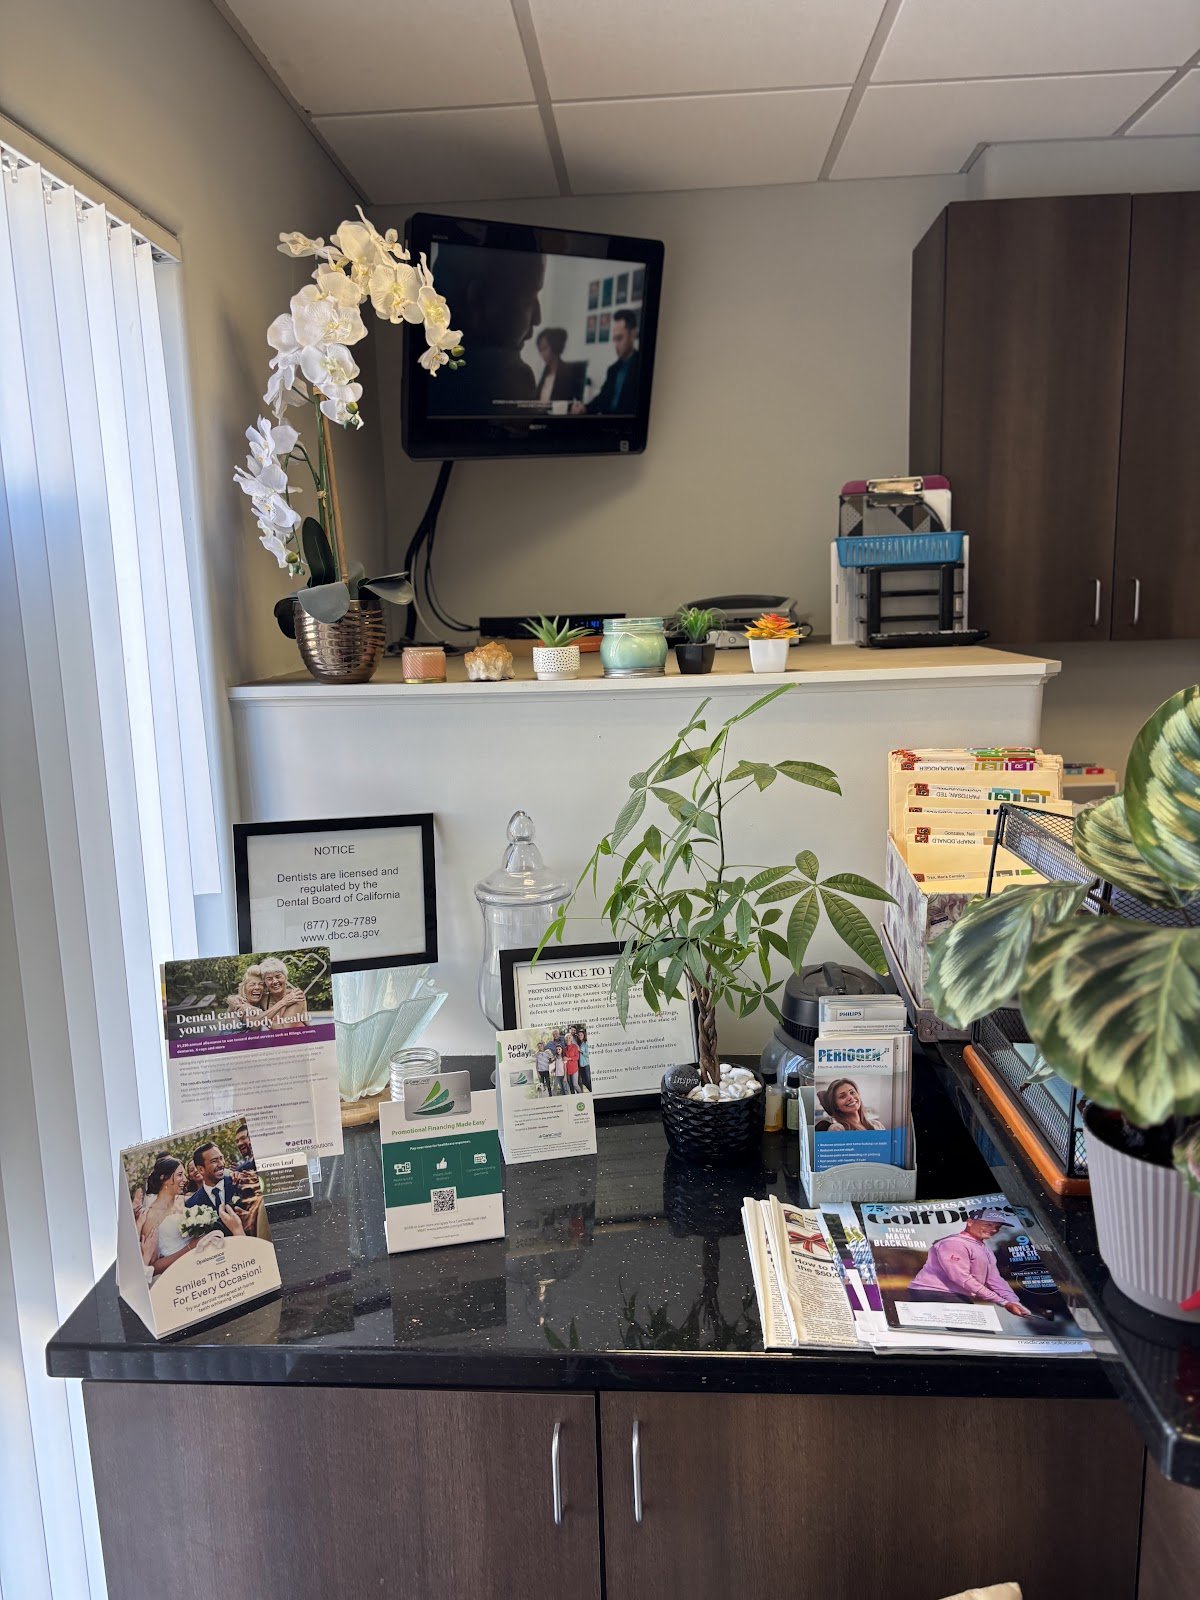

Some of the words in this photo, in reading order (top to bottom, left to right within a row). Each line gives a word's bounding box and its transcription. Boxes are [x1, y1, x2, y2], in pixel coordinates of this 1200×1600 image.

[314, 845, 355, 855] NOTICE
[277, 872, 318, 883] Dentists
[339, 868, 378, 879] licensed
[381, 867, 399, 876] and
[300, 883, 346, 894] regulated
[348, 882, 360, 892] by
[363, 881, 378, 889] the
[277, 897, 309, 908] Dental
[312, 895, 341, 905] Board
[344, 893, 353, 902] of
[356, 891, 401, 901] California
[303, 919, 329, 932] (877)
[332, 916, 377, 928] 729-7789
[301, 929, 380, 943] www.dbc.ca.gov
[545, 969, 587, 980] NOTICE
[589, 967, 605, 976] TO
[176, 1011, 215, 1025] Dental
[218, 1010, 243, 1020] care
[245, 1007, 263, 1017] for
[179, 1025, 207, 1038] your
[209, 1017, 275, 1032] whole-body
[277, 1012, 312, 1025] health
[508, 1043, 528, 1051] Apply
[508, 1050, 532, 1059] Today!
[818, 1048, 881, 1062] PERIOGEN
[672, 1076, 699, 1086] Inspire
[392, 1127, 427, 1136] Promotional
[428, 1123, 455, 1132] Financing
[286, 1145, 310, 1153] medicare
[311, 1141, 333, 1150] solutions
[291, 1138, 312, 1147] aetna
[832, 1180, 896, 1190] MAISON
[890, 1198, 983, 1212] ANNIVERSARY
[986, 1194, 1007, 1203] ISS
[874, 1240, 927, 1248] BLACKBURN
[1016, 1236, 1030, 1245] 9
[1008, 1245, 1030, 1253] MOVES
[795, 1258, 816, 1267] How
[797, 1265, 812, 1273] the
[176, 1277, 207, 1295] Smiles
[208, 1268, 229, 1282] That
[232, 1258, 256, 1272] Shine
[173, 1296, 189, 1308] For
[192, 1286, 217, 1301] Every
[219, 1266, 262, 1289] Occasion!
